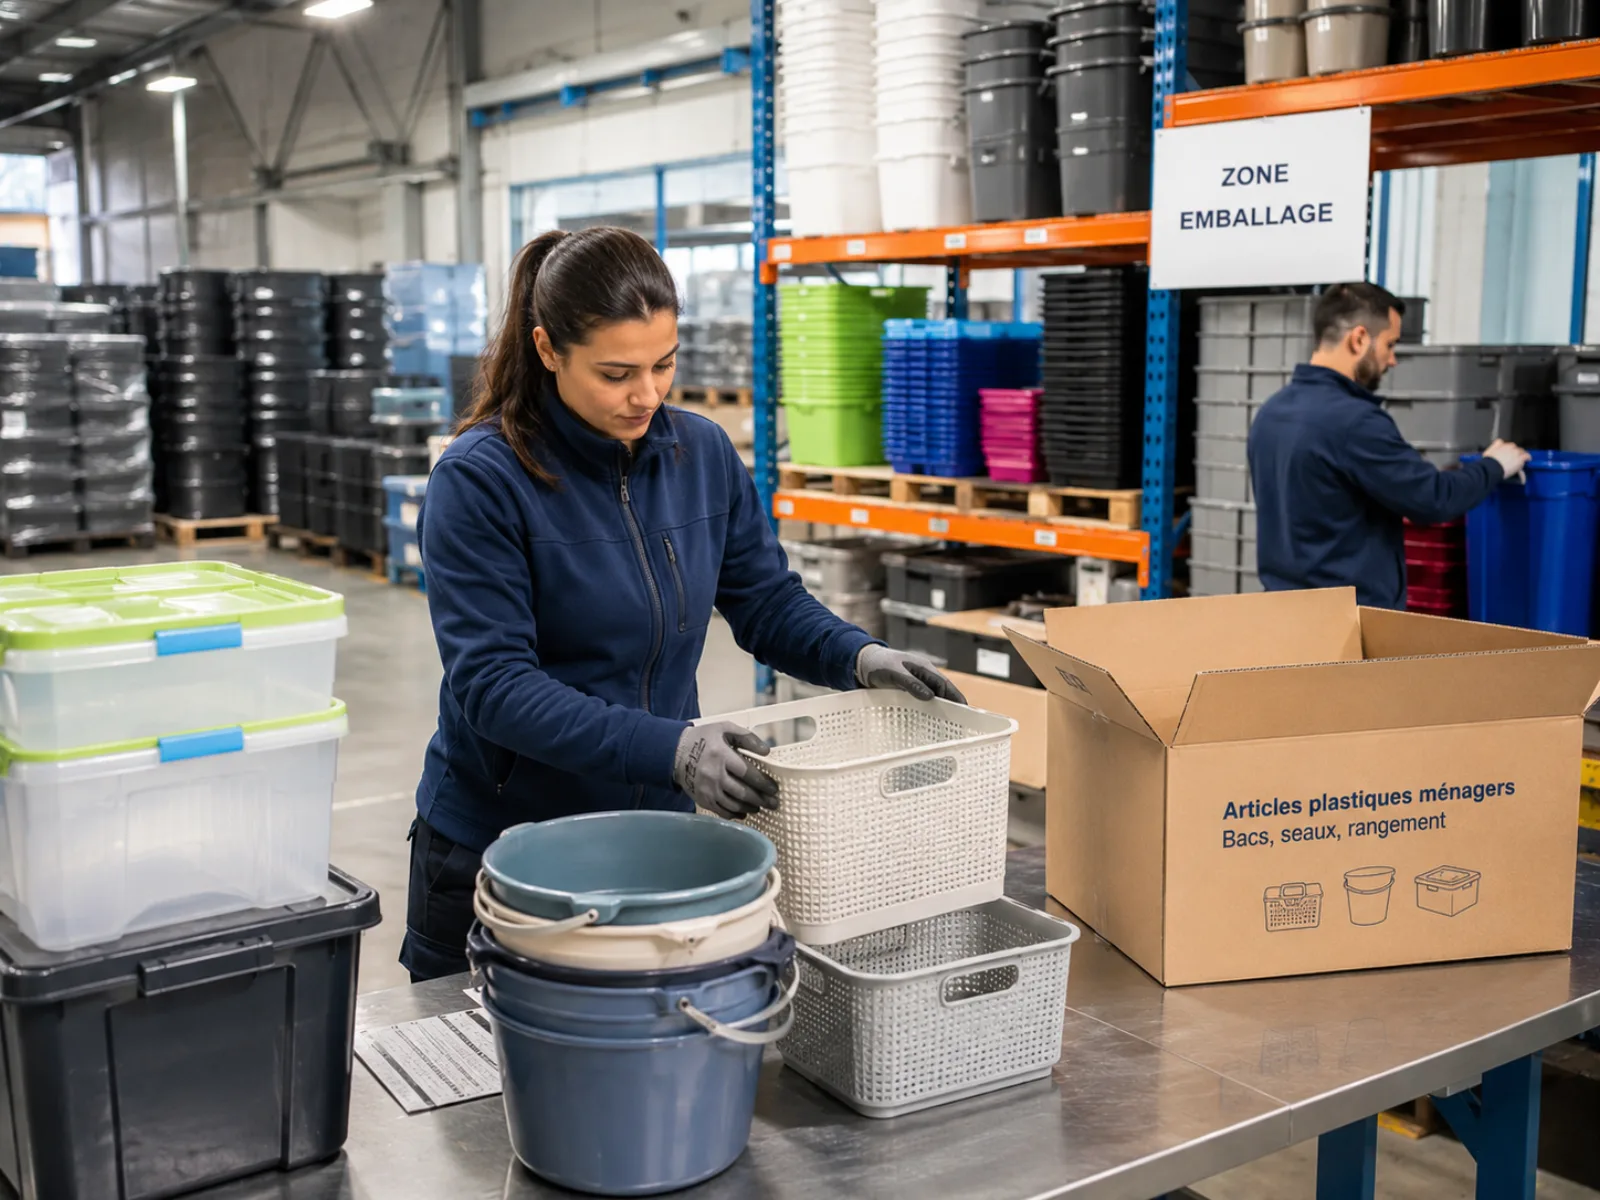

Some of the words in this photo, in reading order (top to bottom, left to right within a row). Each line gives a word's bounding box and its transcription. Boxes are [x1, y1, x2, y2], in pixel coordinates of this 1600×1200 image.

[1221, 163, 1289, 187] ZONE
[1180, 203, 1333, 230] EMBALLAGE
[1222, 797, 1302, 820] Articles
[1309, 788, 1412, 817] plastiques
[1419, 780, 1516, 803] ménagers
[1222, 829, 1274, 848] Bacs,
[1280, 824, 1341, 844] seaux,
[1348, 811, 1446, 839] rangement
